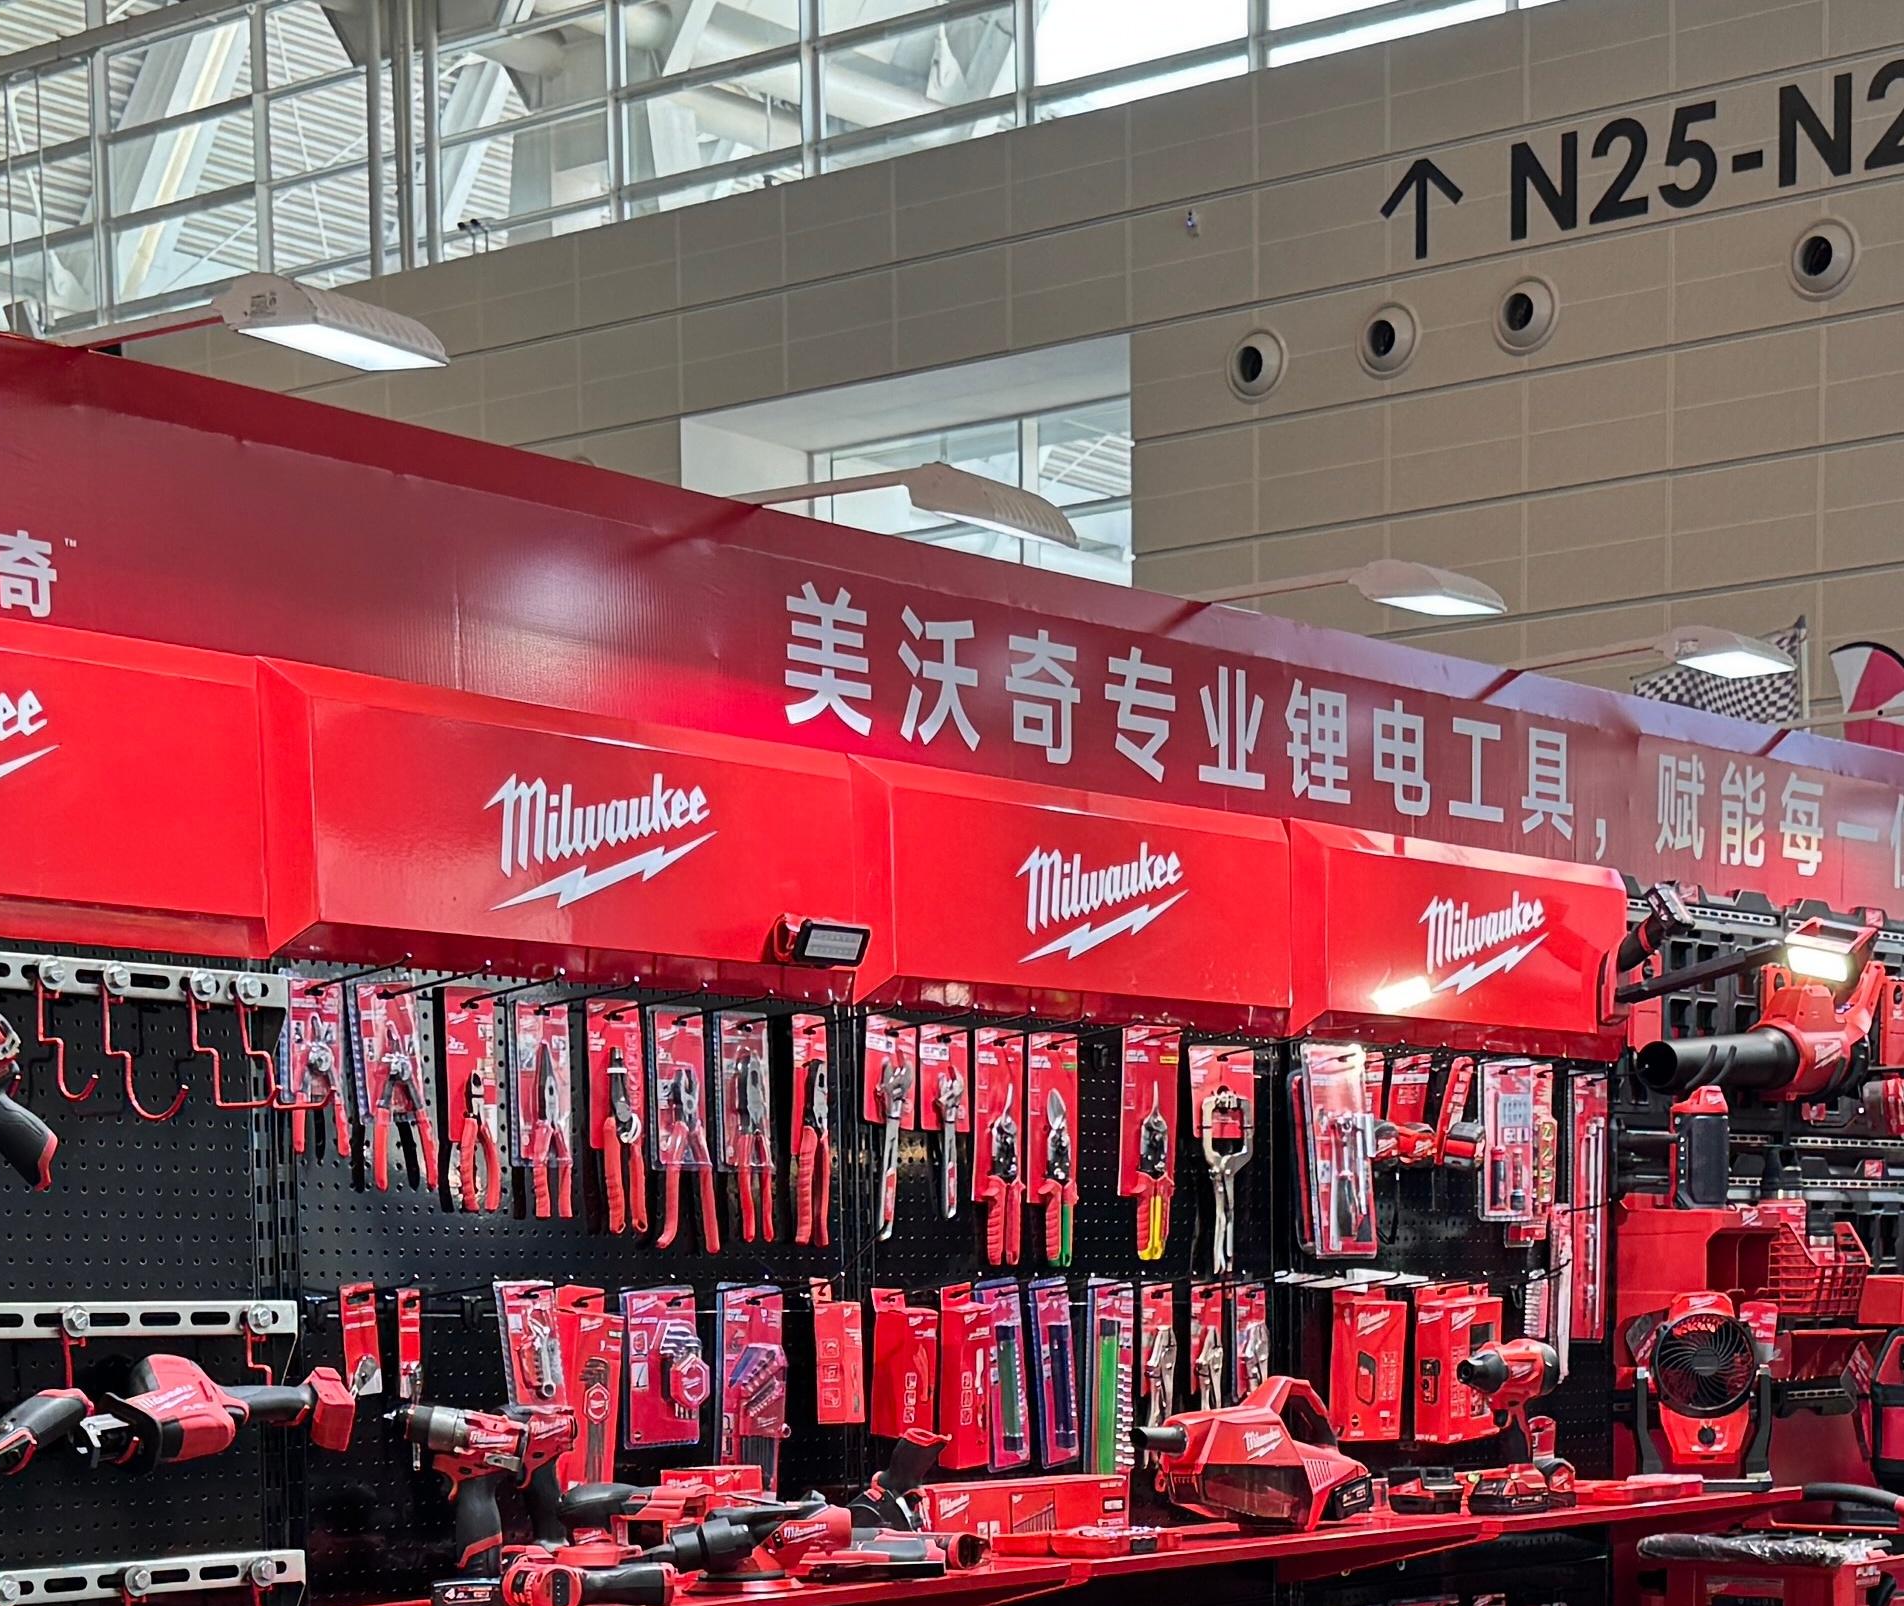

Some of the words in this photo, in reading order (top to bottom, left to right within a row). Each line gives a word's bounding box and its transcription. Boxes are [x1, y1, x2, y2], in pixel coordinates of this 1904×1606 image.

[485, 773, 707, 878] Milwaukee
[1016, 841, 1181, 934] Milwaukee
[1418, 889, 1544, 971] Milwaukee
